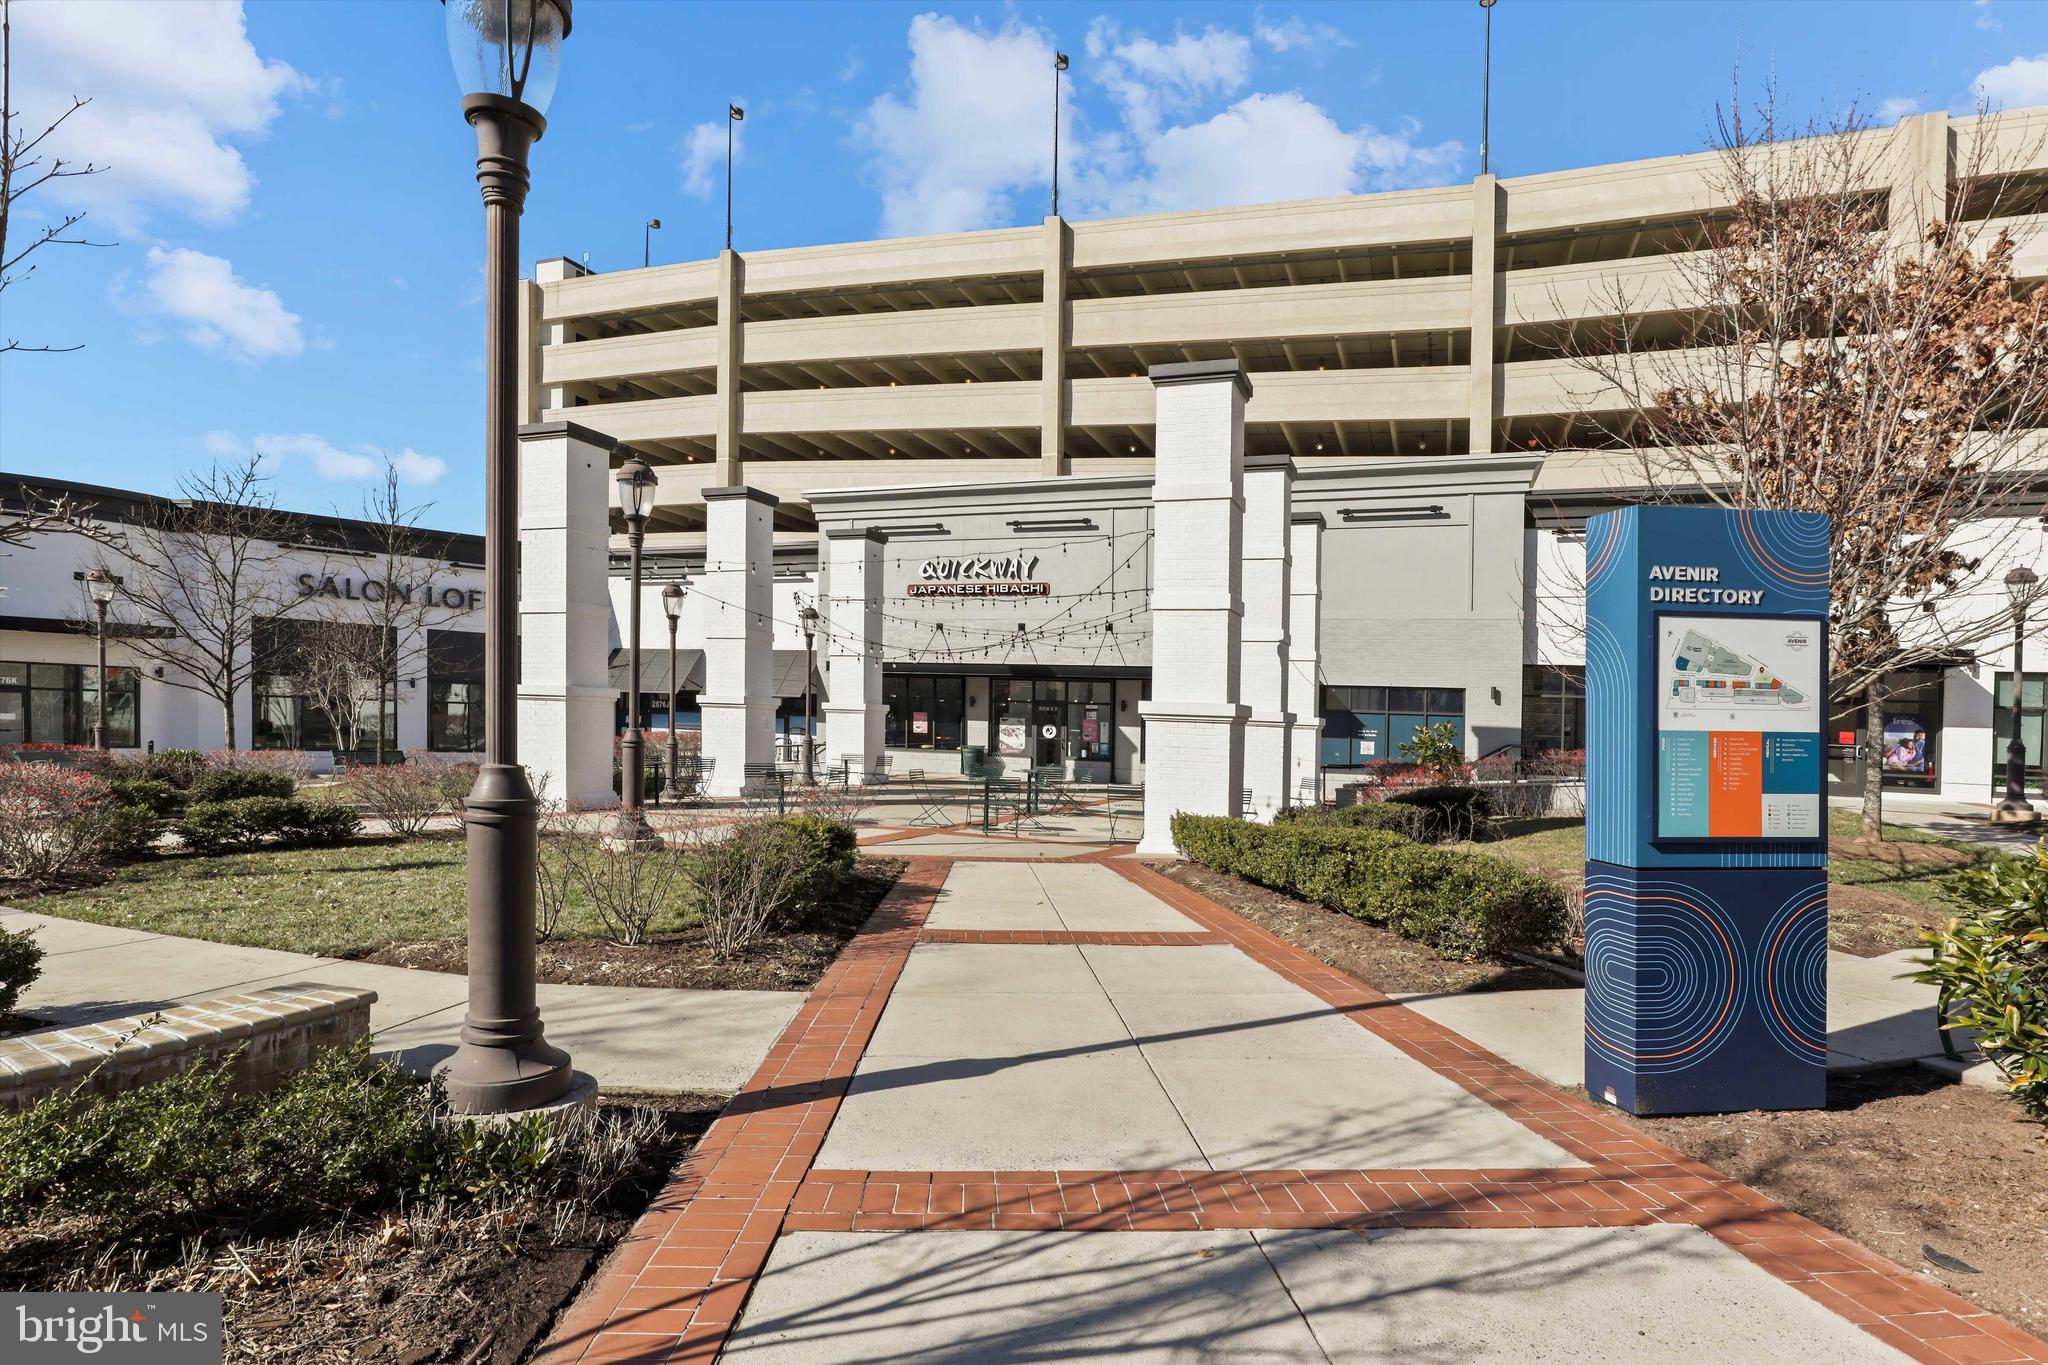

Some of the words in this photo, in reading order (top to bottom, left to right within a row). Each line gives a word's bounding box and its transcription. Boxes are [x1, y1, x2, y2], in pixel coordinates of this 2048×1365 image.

[918, 556, 1039, 581] QUICKWAY
[1648, 564, 1719, 582] AVENIR
[298, 573, 411, 605] SALON
[426, 585, 485, 611] LOF
[909, 584, 983, 595] JAPANESE
[986, 583, 1043, 594] HIBACHI
[1649, 586, 1764, 606] DIRECTORY
